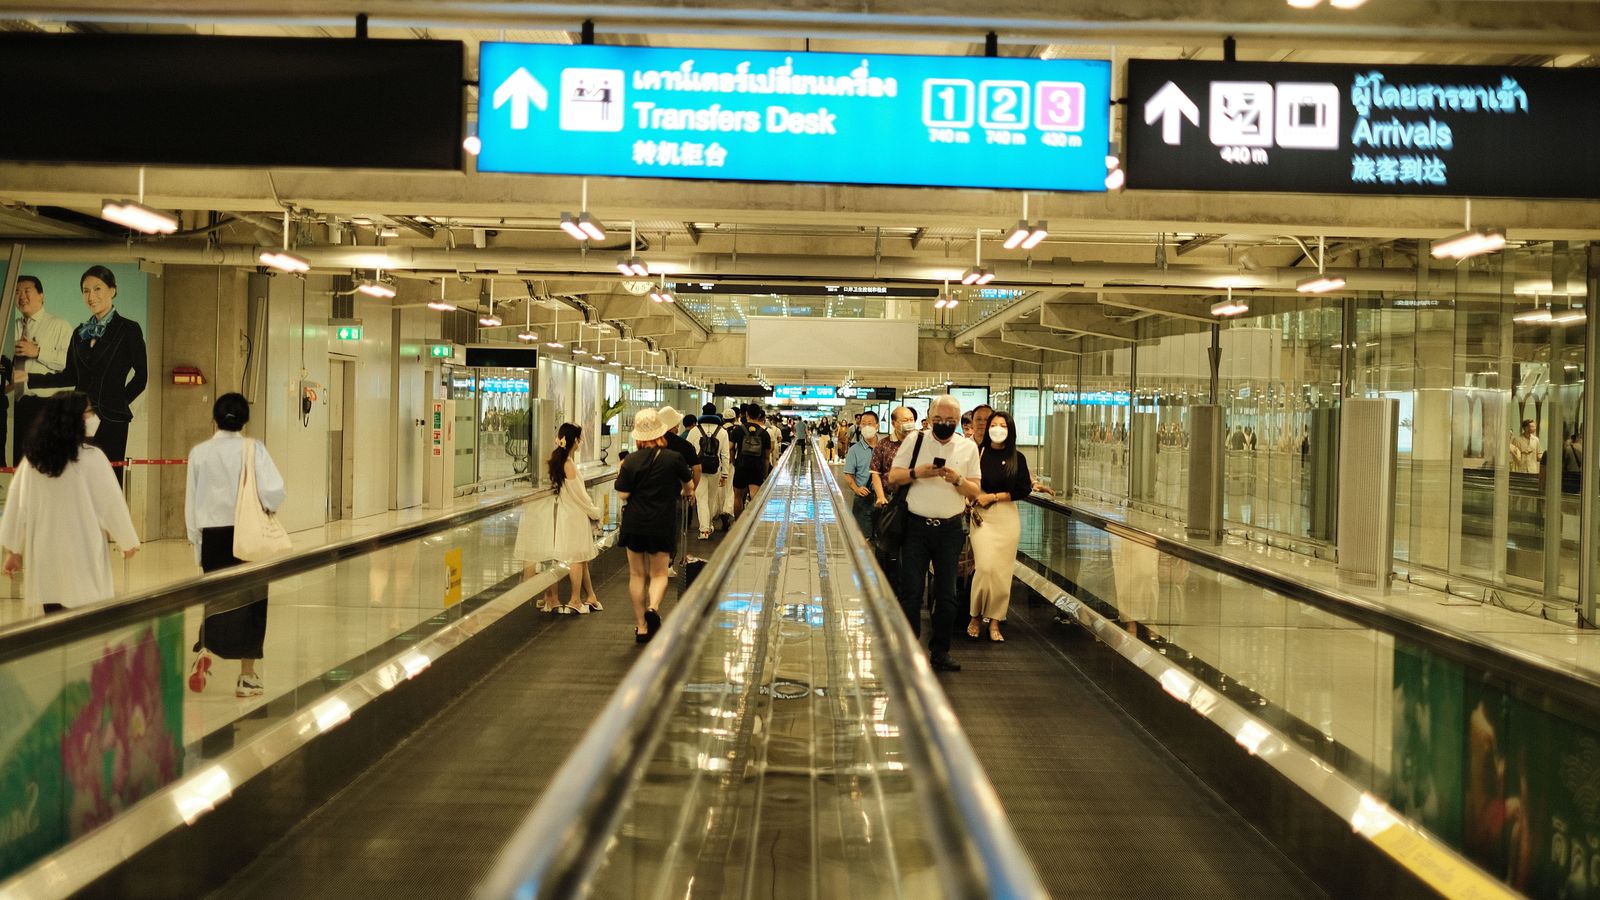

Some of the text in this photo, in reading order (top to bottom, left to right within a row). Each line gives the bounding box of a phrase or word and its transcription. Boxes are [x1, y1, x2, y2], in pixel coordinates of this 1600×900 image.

[938, 86, 954, 121] 1
[992, 87, 1018, 123] 2
[1047, 89, 1072, 124] 3
[1351, 71, 1529, 117] ผู้โดยสารขาเข้า
[632, 101, 837, 135] Transfers Desk
[1351, 115, 1454, 150] Arrivals
[632, 139, 728, 167] 转机柜台
[955, 131, 970, 143] m
[1012, 132, 1026, 144] m
[1068, 134, 1082, 147] m
[1251, 148, 1269, 165] m
[1351, 153, 1448, 185] 旅客到达
